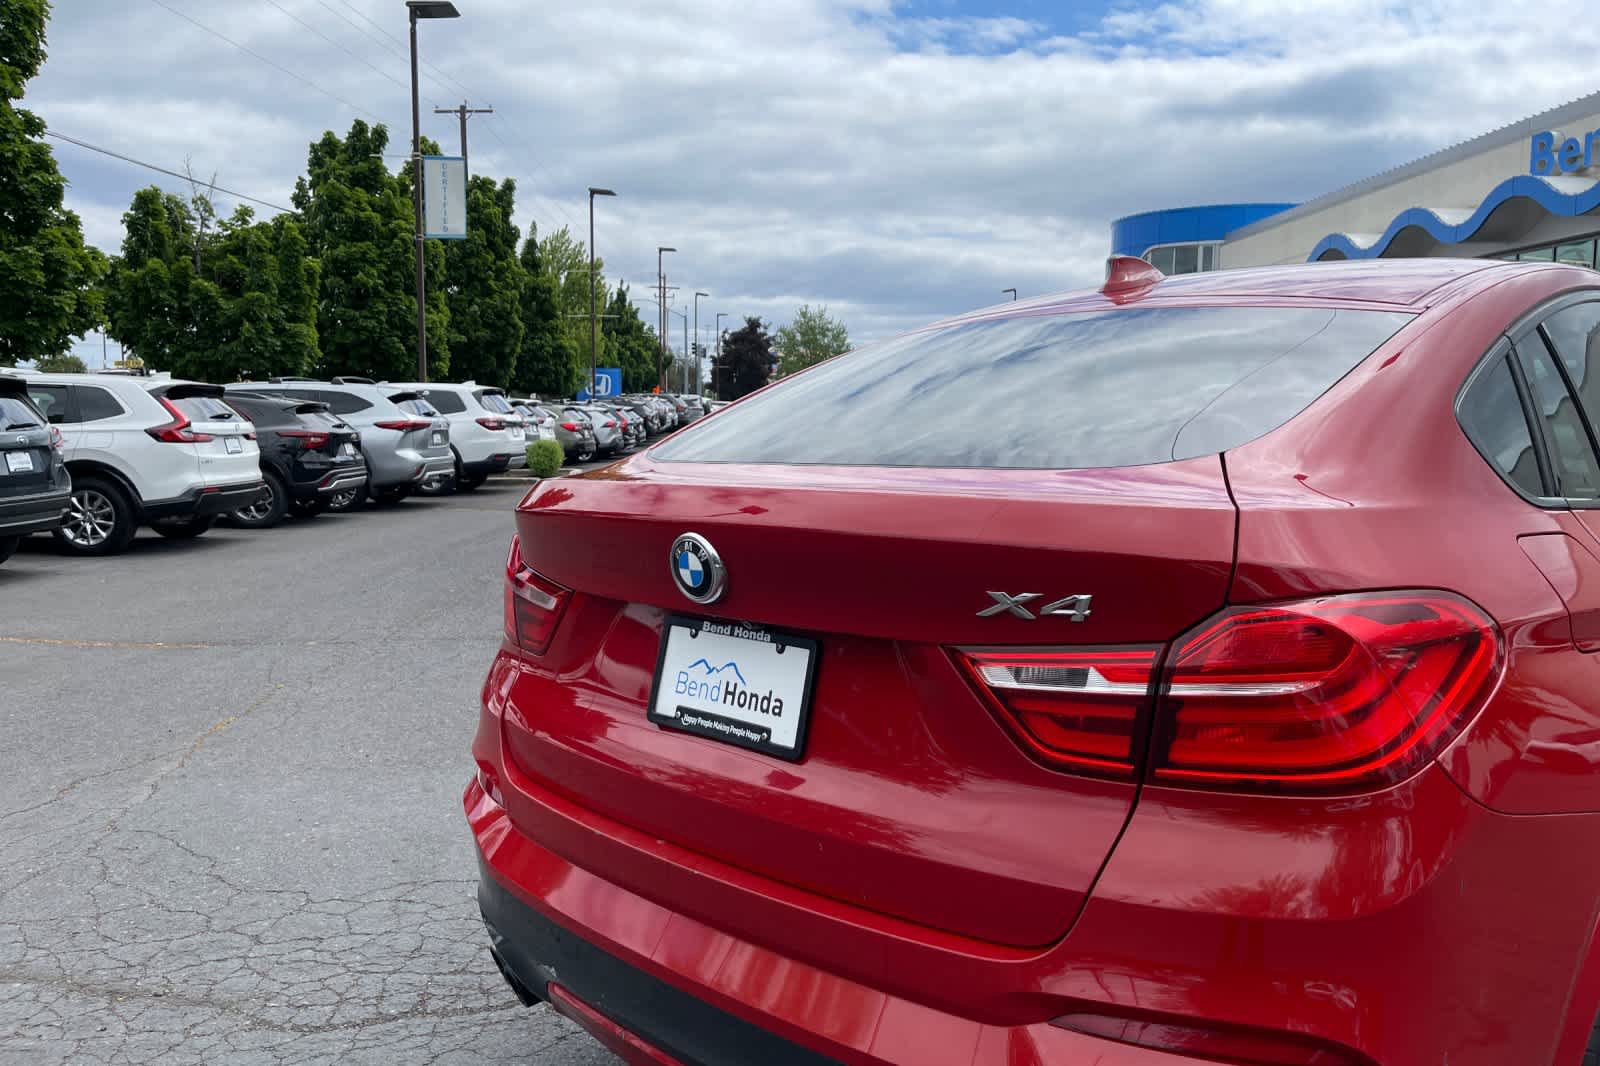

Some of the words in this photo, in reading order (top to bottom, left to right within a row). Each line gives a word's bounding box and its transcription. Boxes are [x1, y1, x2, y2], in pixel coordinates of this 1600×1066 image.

[975, 590, 1093, 622] X4
[702, 620, 732, 635] Bend
[733, 626, 771, 642] Honda
[683, 713, 698, 726] Happy
[698, 716, 713, 729] People
[712, 720, 730, 734] Making
[730, 724, 746, 737] People
[745, 729, 761, 743] Happy
